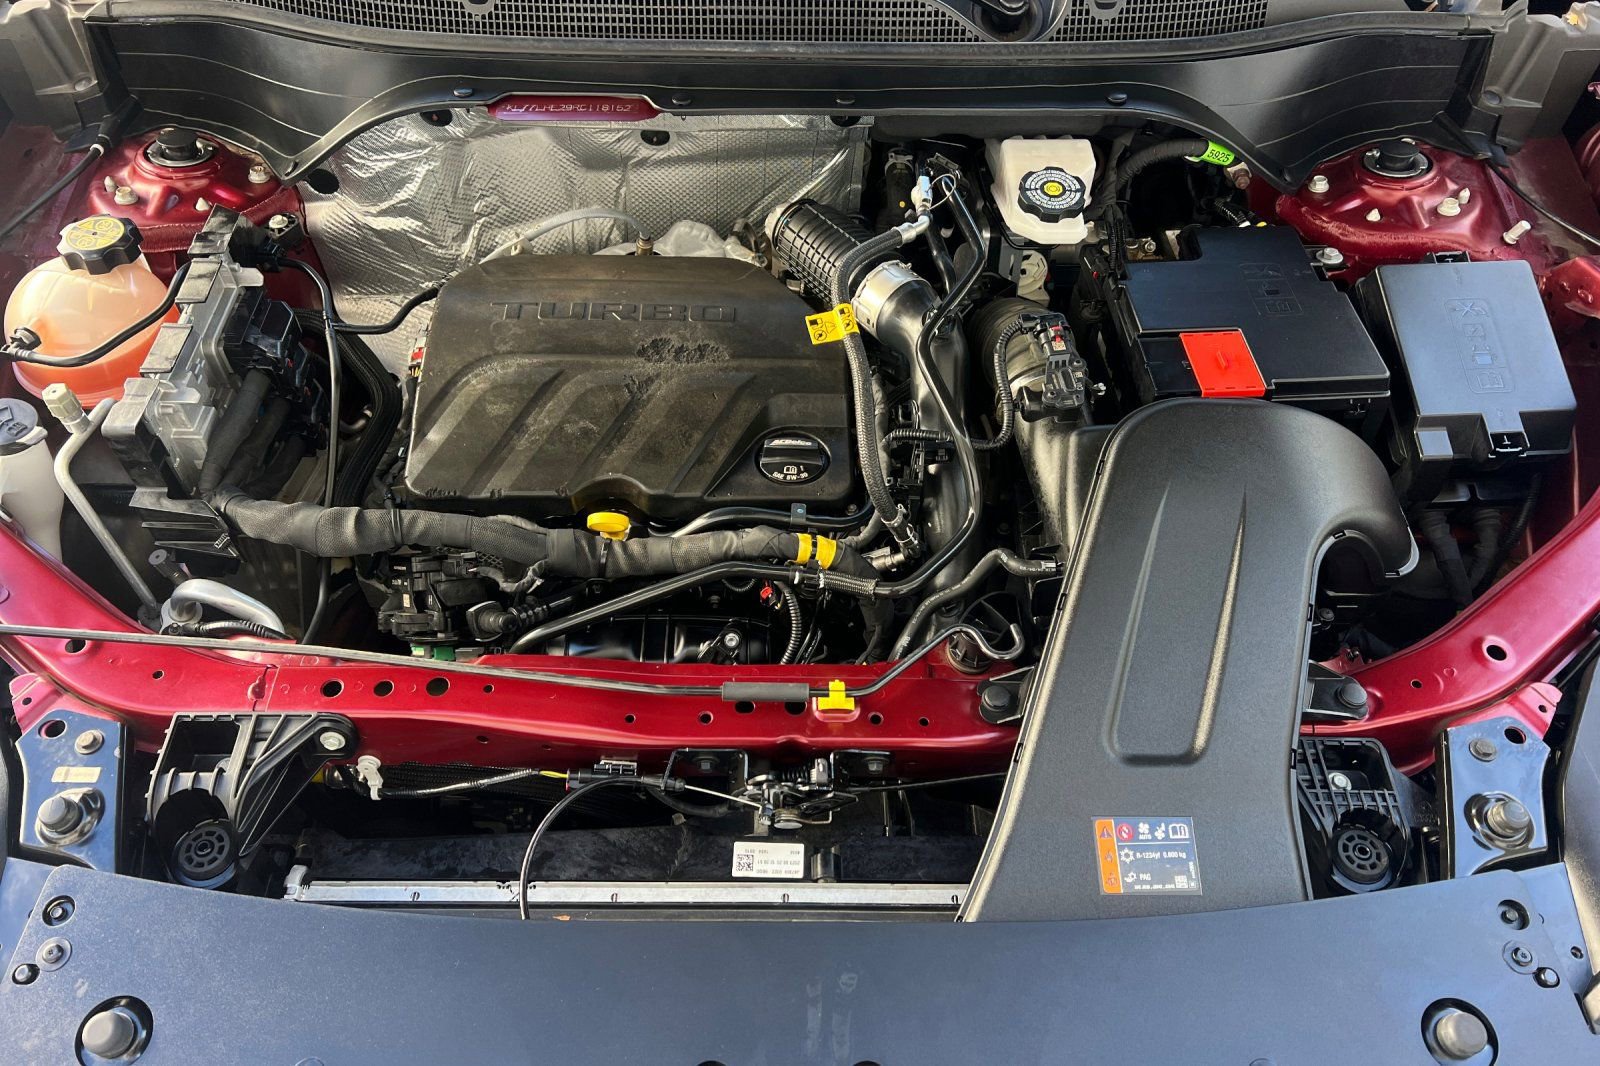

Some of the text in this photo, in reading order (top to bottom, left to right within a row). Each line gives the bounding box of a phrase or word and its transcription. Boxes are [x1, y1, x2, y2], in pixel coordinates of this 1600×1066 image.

[490, 303, 735, 321] TURBO
[772, 471, 785, 480] SAE
[1136, 851, 1160, 860] R-1234yf
[1178, 851, 1187, 859] kg
